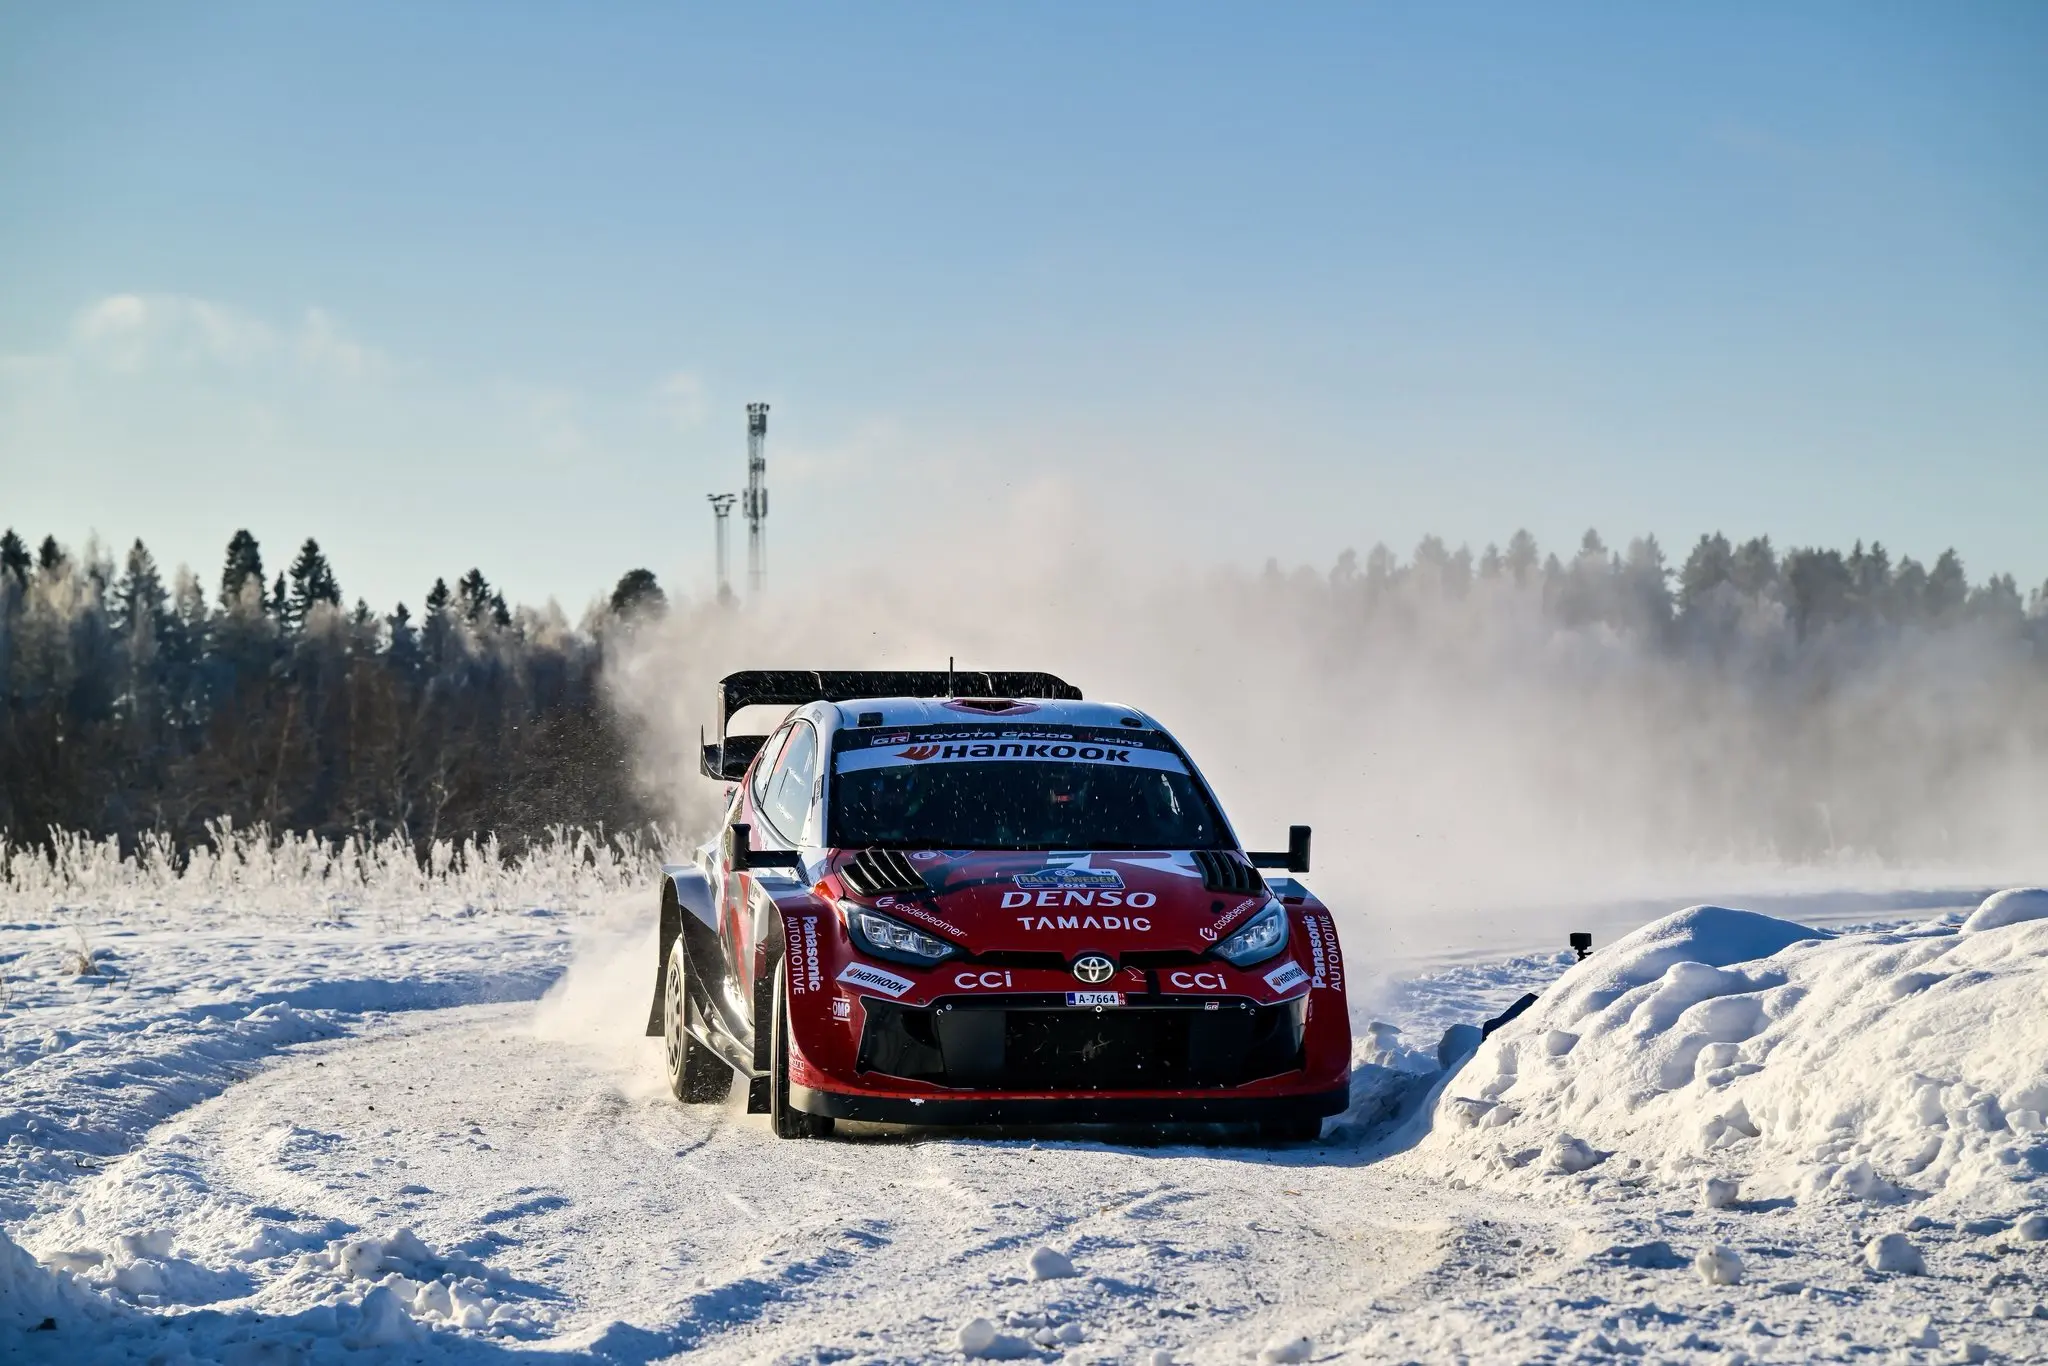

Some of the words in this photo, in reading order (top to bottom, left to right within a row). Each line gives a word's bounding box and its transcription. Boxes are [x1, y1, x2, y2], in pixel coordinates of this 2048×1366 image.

[873, 736, 906, 745] GR
[916, 732, 996, 740] TOYOTA
[1001, 731, 1073, 740] GAZOO
[1021, 875, 1058, 883] RALLY
[1063, 875, 1117, 883] SWEDEN
[1000, 890, 1157, 908] DENSO
[895, 903, 965, 937] codebeamer
[1017, 916, 1152, 931] TAMADIC
[1213, 899, 1255, 930] codebeamer
[787, 916, 805, 995] AUTOMOTIVE
[802, 916, 823, 992] Panasonic
[1303, 915, 1327, 989] Panasonic
[1318, 915, 1342, 992] AUTOMOTIVE
[833, 1001, 850, 1017] OMP
[1079, 994, 1115, 1003] A-7664
